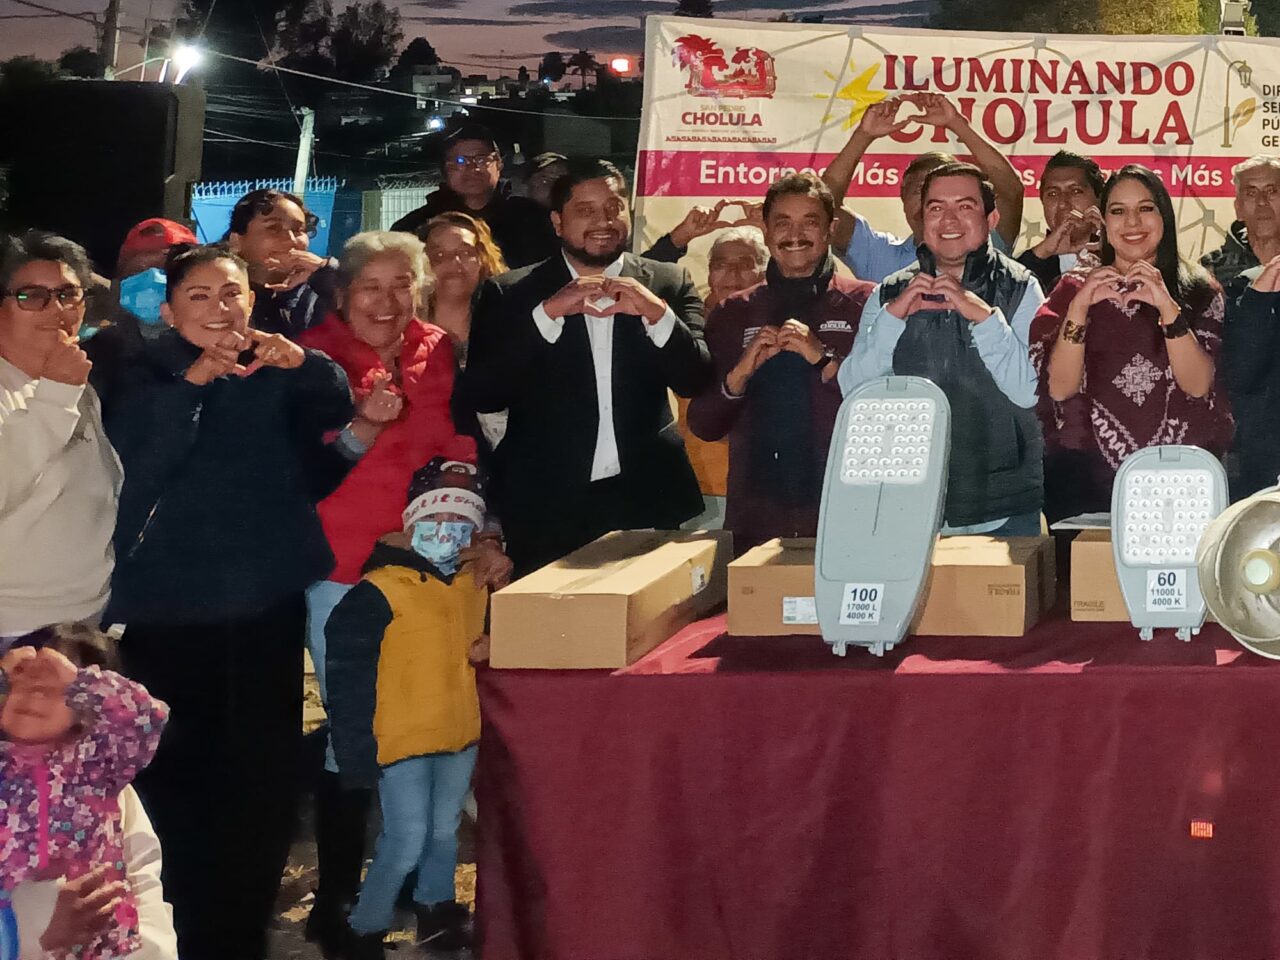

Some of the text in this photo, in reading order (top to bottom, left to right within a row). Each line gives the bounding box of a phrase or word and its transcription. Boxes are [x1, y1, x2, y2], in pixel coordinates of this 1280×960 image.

[883, 54, 1195, 96] ILUMINANDO
[700, 104, 717, 112] SAN
[681, 111, 763, 127] CHOLULA
[1171, 163, 1223, 186] Más
[1157, 571, 1176, 587] 60
[850, 588, 878, 602] 100
[1151, 588, 1183, 597] 11000 L
[847, 603, 870, 611] 17000
[1152, 598, 1172, 606] 4000
[846, 612, 875, 620] 4000 K
